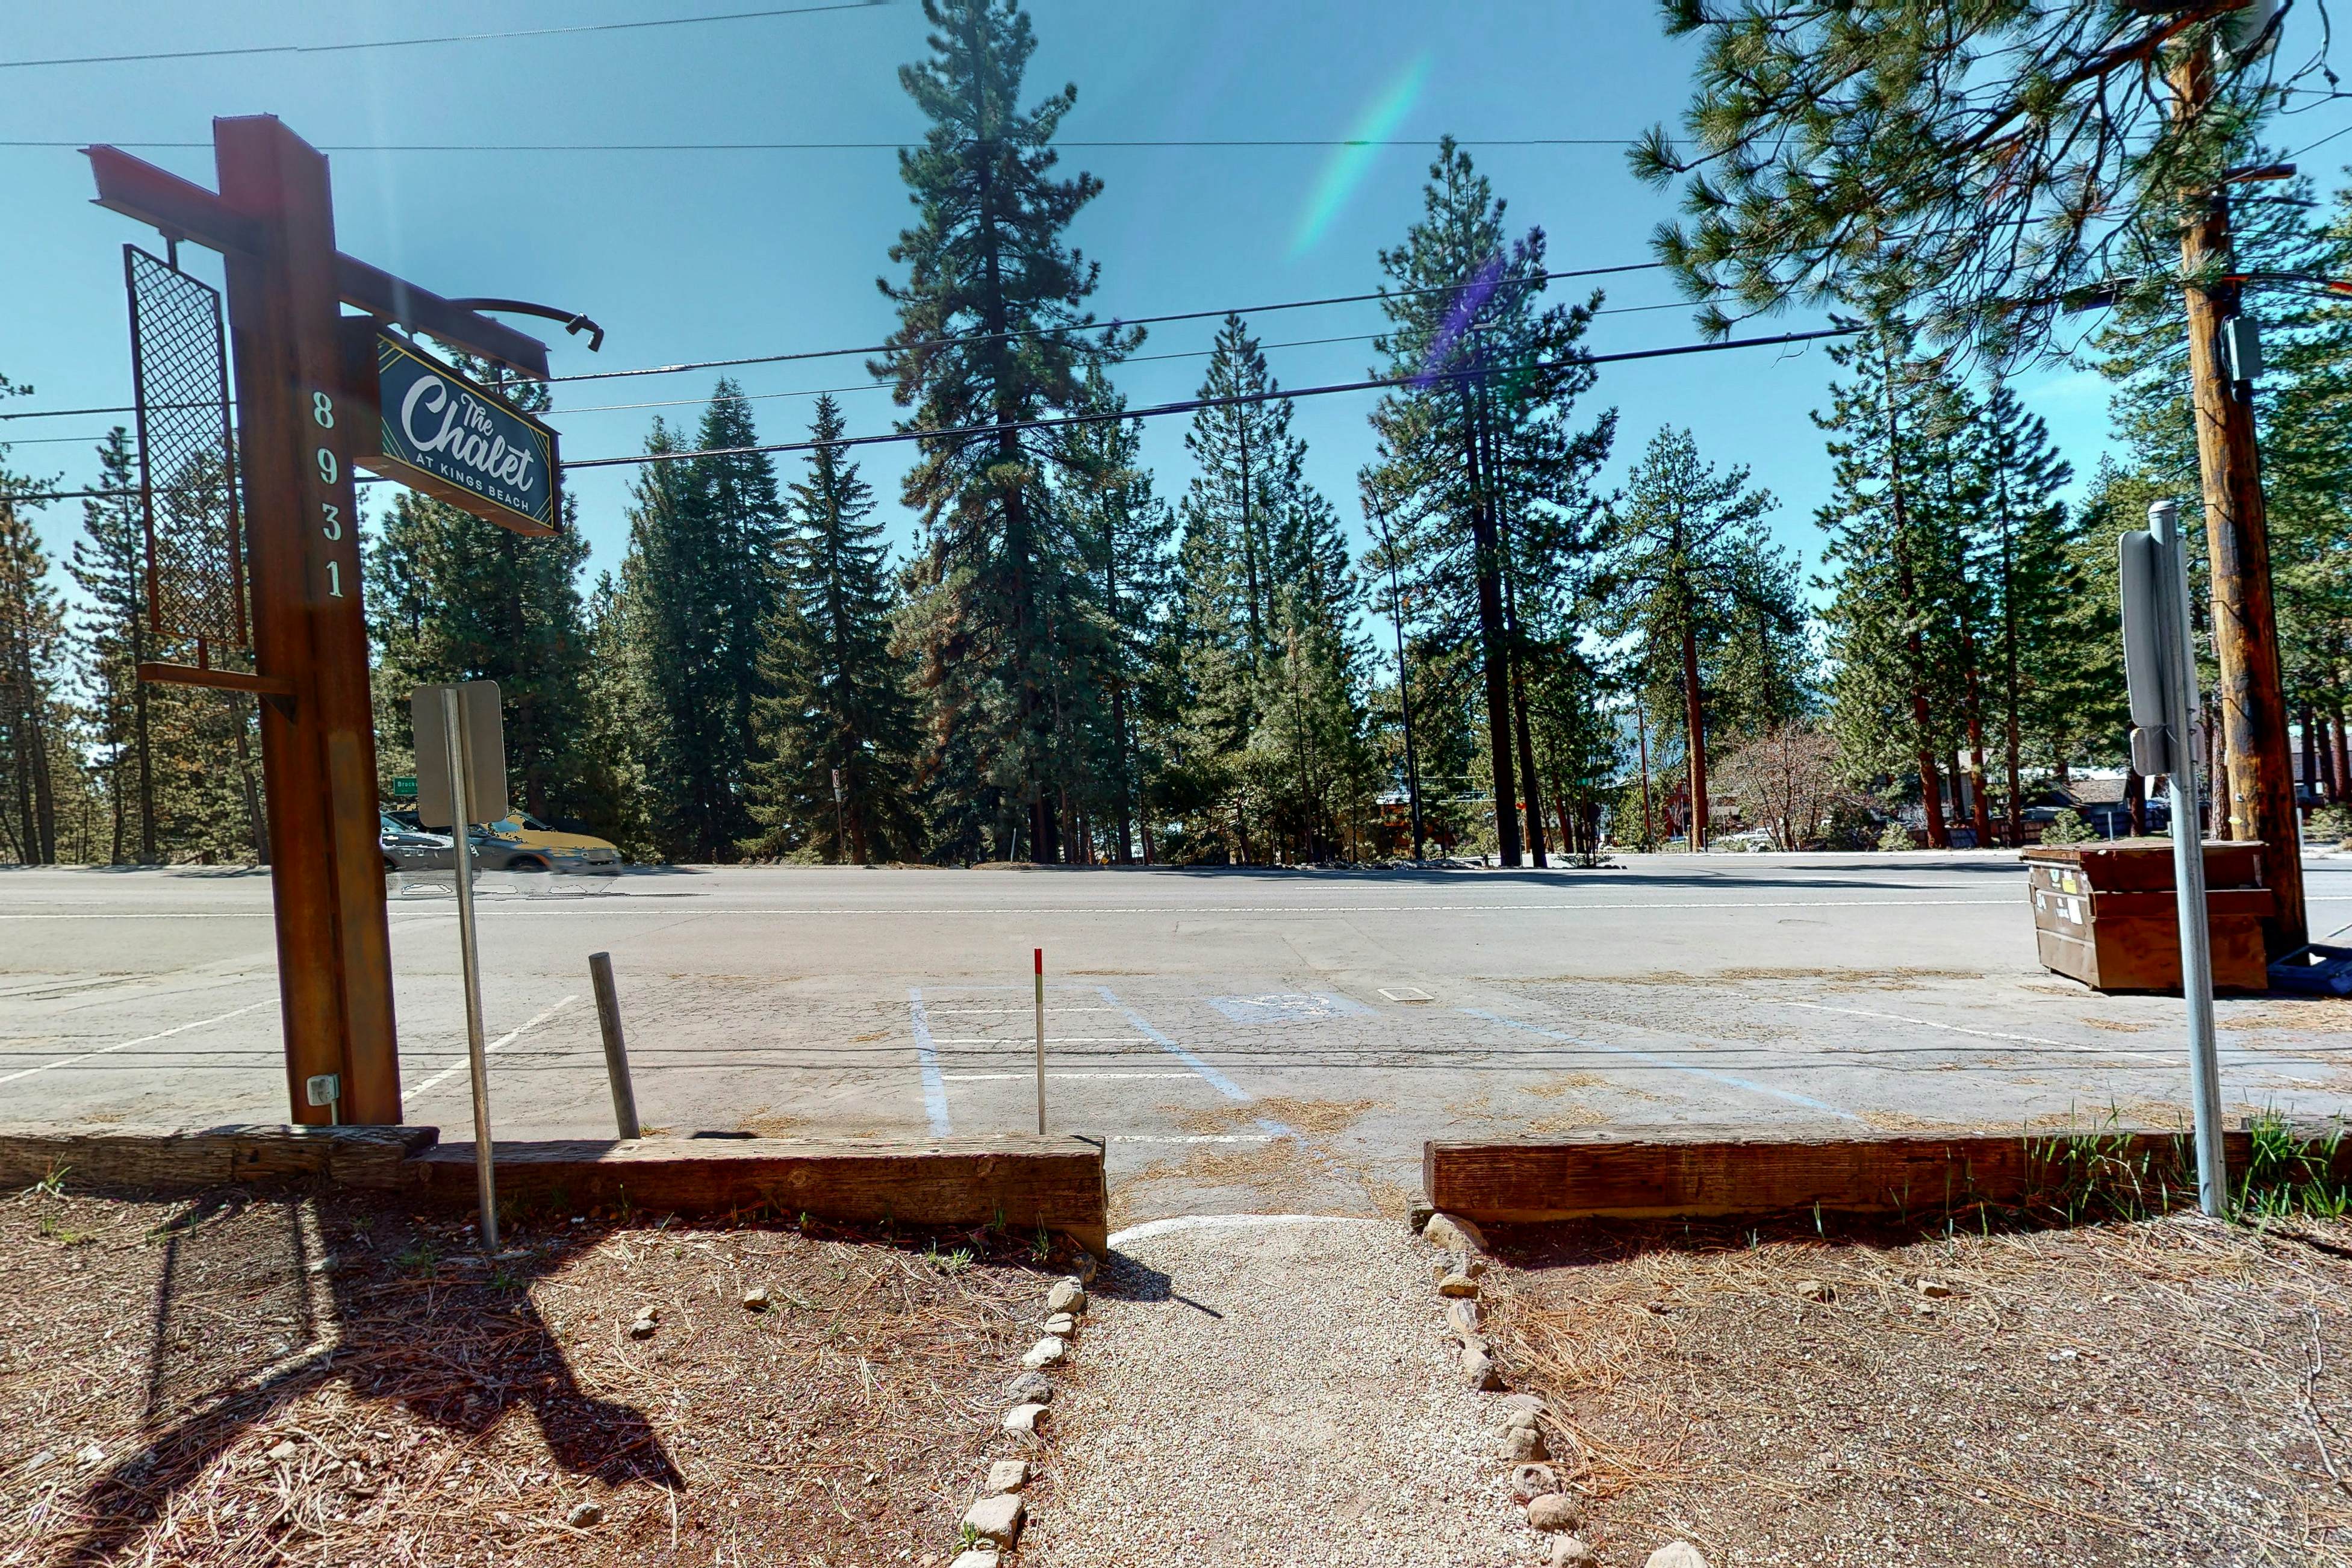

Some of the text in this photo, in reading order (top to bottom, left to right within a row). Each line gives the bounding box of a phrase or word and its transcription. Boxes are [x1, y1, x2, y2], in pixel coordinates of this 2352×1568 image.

[401, 375, 534, 492] Chalet
[461, 393, 494, 437] The
[313, 391, 344, 598] 8931
[416, 453, 529, 512] AT KINGS BEACH
